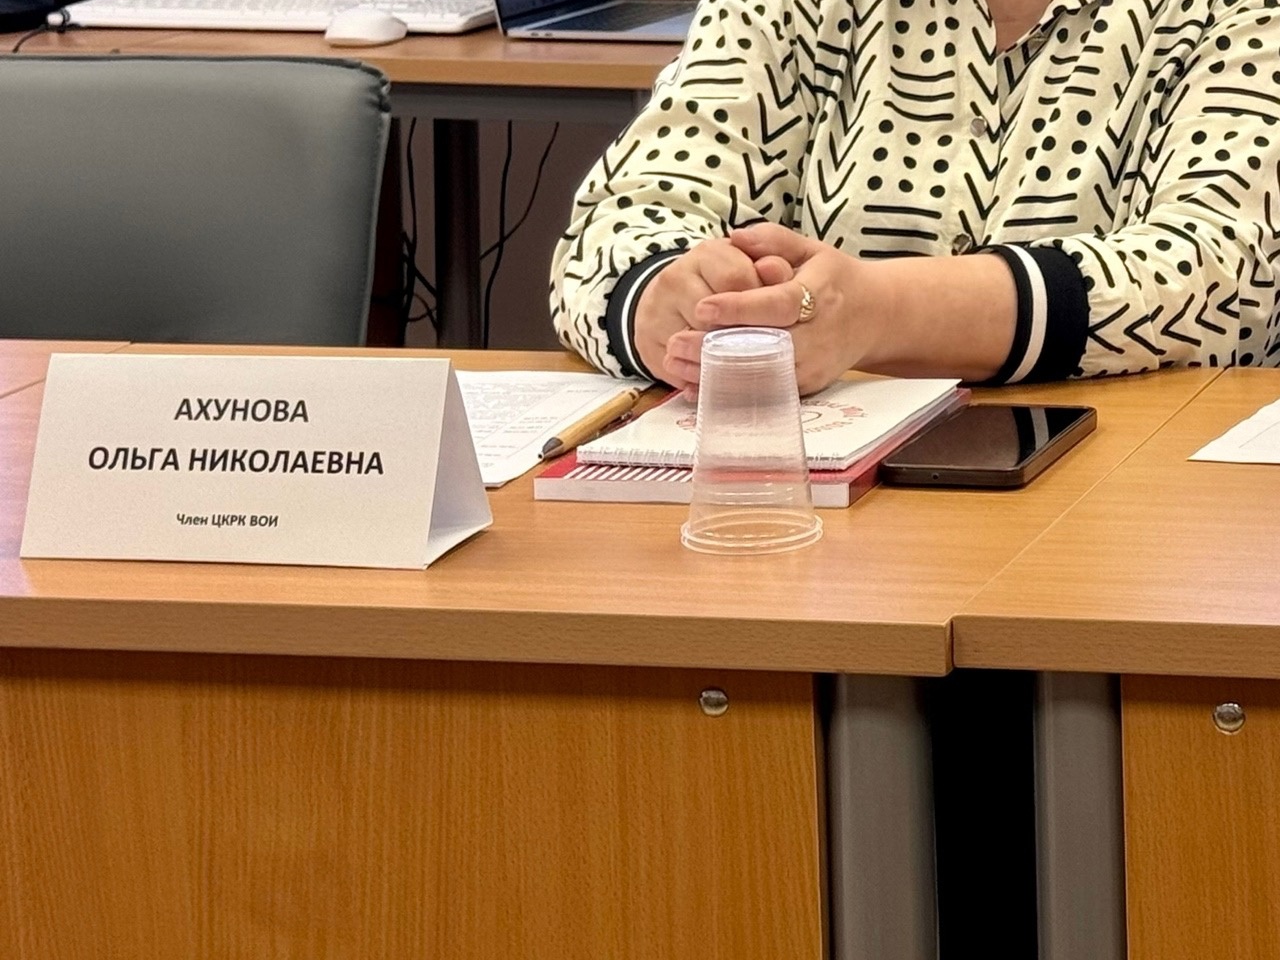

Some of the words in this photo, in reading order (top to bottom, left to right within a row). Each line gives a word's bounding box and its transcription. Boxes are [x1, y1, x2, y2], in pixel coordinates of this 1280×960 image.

[174, 398, 309, 423] АХУНОВА
[88, 446, 180, 471] ОЛЬГА
[188, 448, 384, 475] НИКОЛАЕВНА
[176, 513, 208, 526] Член
[211, 514, 247, 528] ЦКРК
[249, 515, 279, 527] ВОИ
